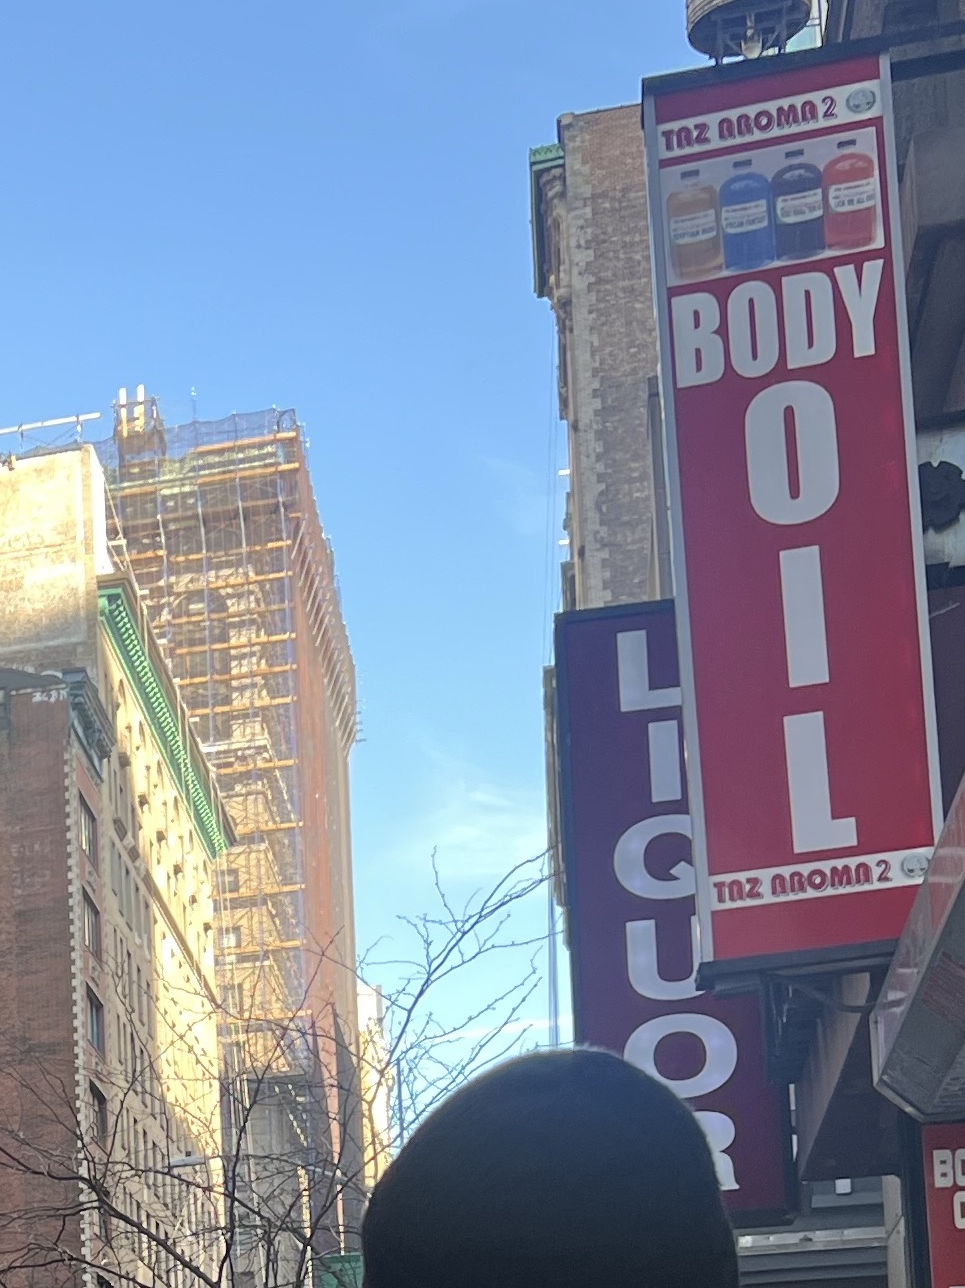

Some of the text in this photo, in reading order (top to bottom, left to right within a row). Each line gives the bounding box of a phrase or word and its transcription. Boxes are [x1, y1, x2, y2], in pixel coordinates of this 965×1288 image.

[661, 95, 838, 152] TAZ AROMA 2
[670, 258, 884, 389] BODY
[744, 380, 858, 854] OIL
[714, 859, 893, 904] TAZ AROMA 2
